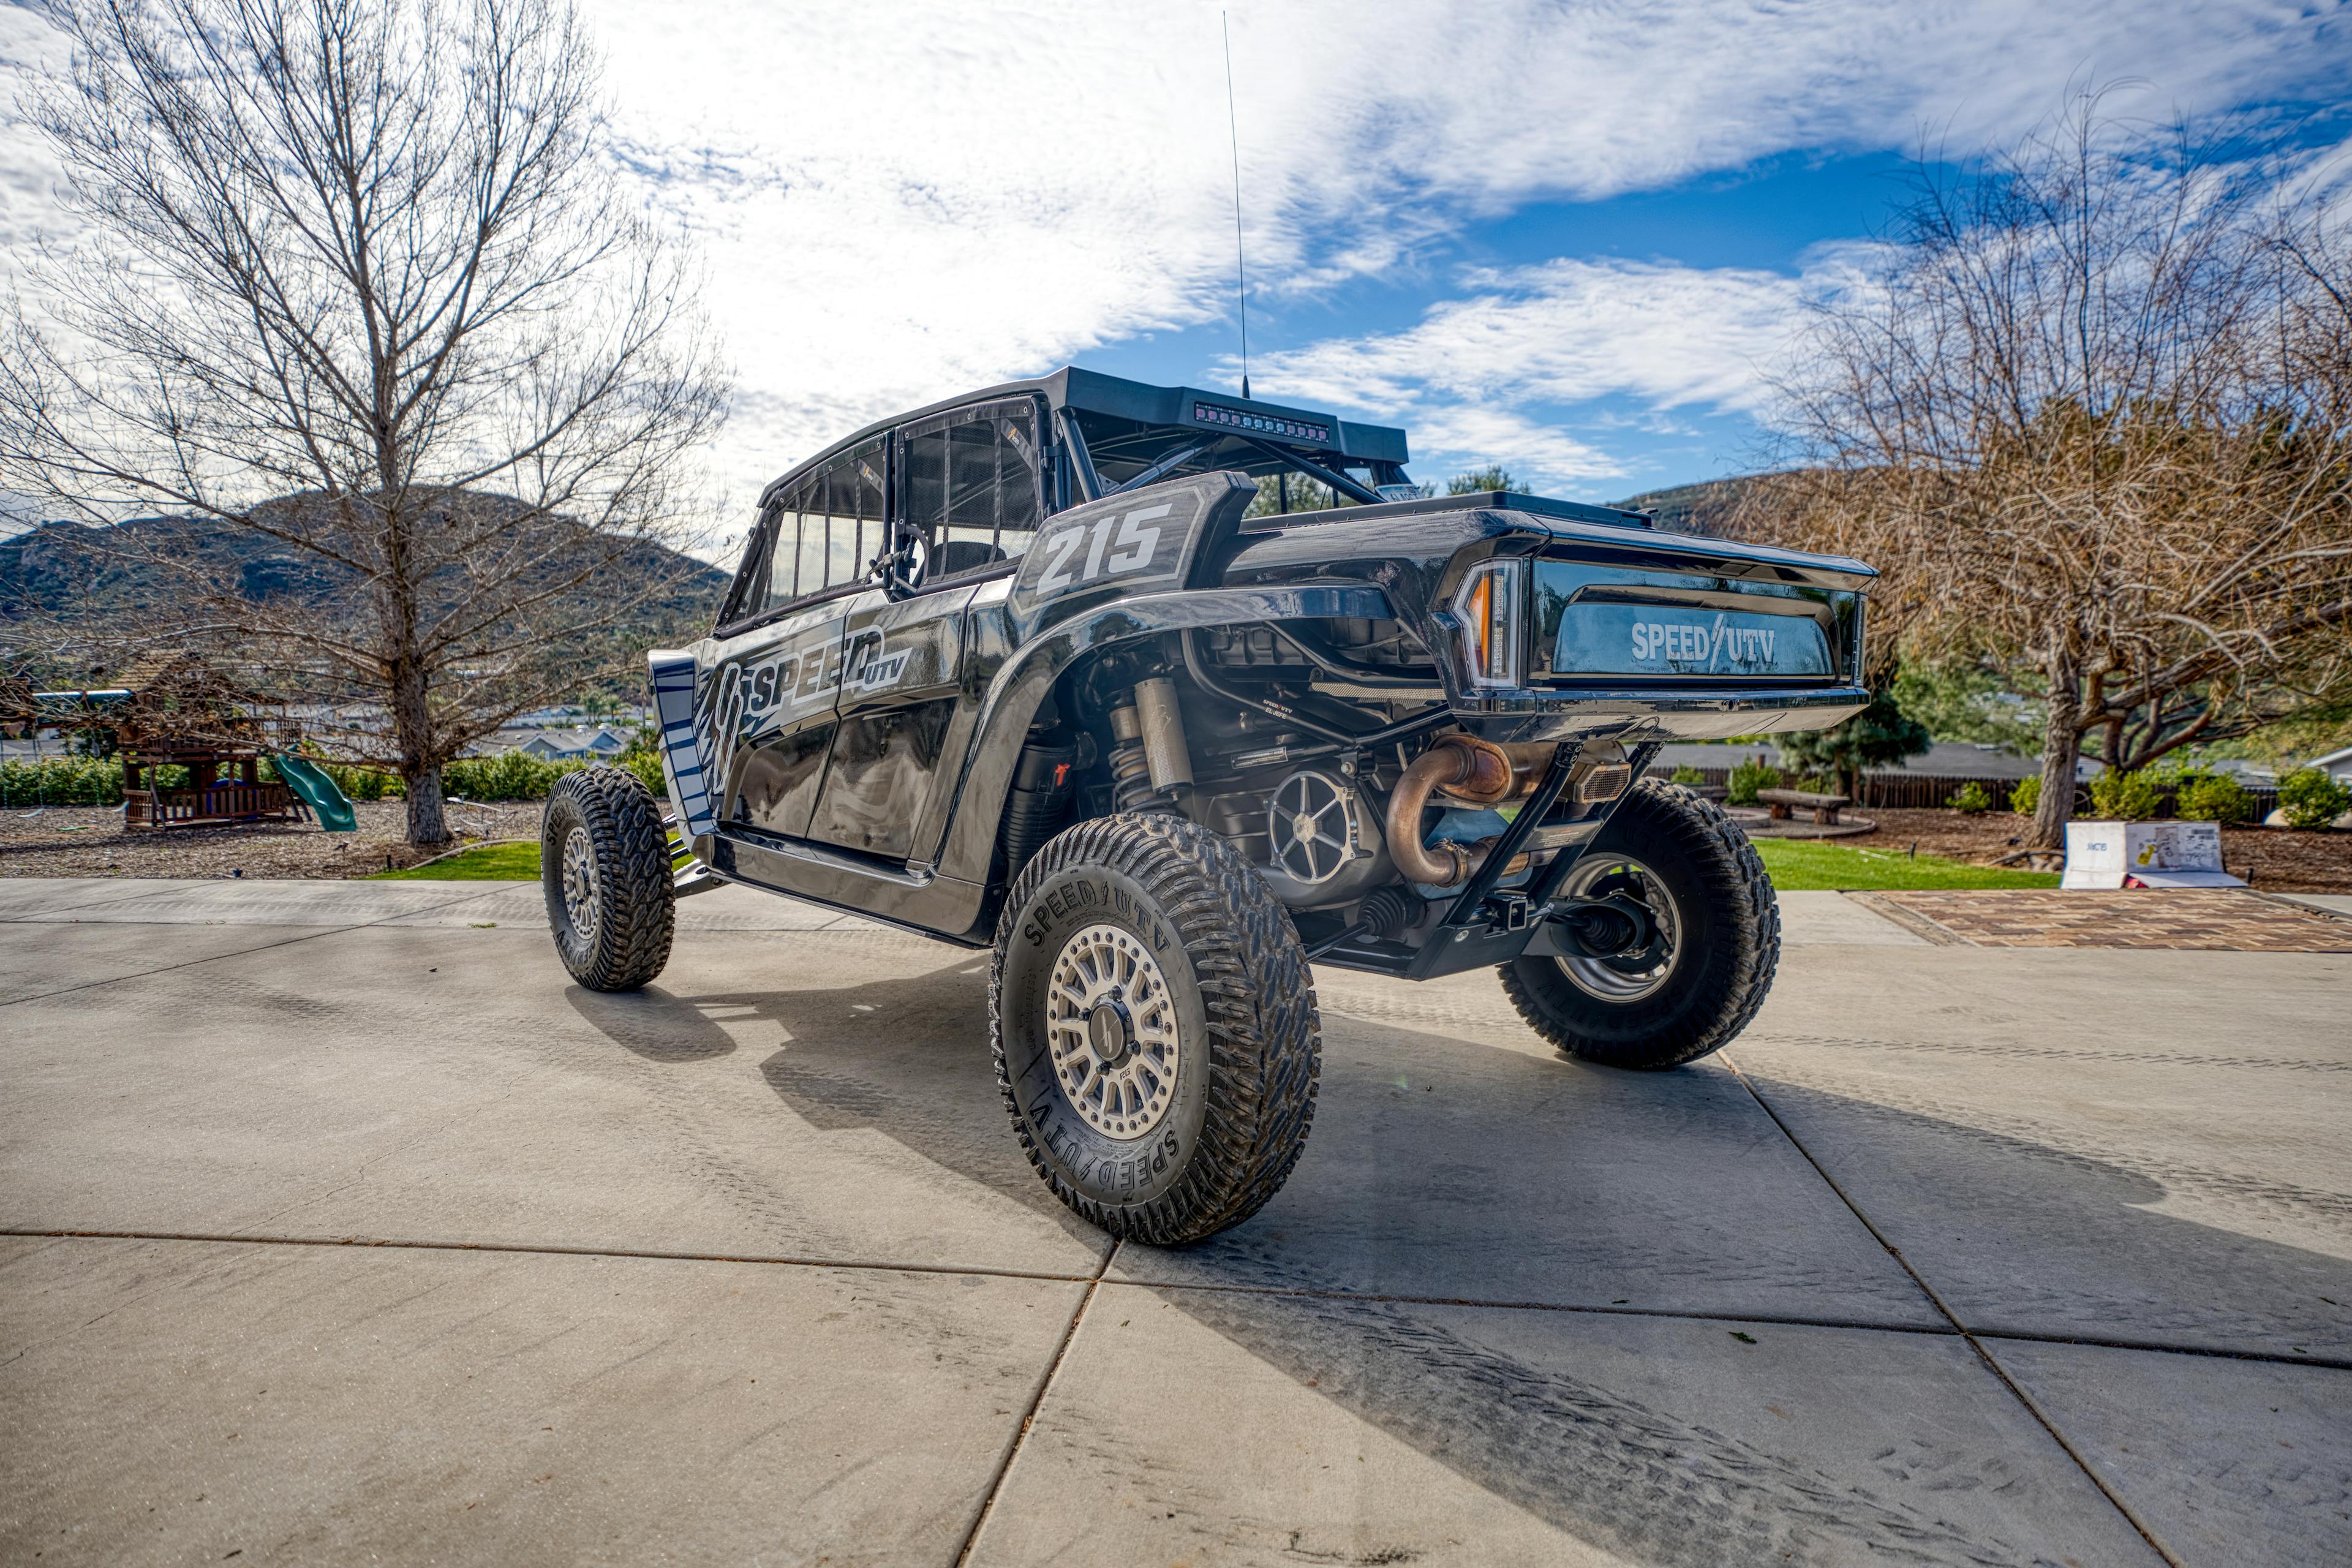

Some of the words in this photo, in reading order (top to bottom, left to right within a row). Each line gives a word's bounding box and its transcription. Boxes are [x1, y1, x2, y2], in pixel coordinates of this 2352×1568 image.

[1036, 503, 1172, 595] 215
[748, 627, 883, 714] SPEED
[864, 656, 905, 685] UTV
[1631, 622, 1710, 662] SPEED
[1727, 628, 1775, 663] UTV
[1263, 699, 1278, 708] SPEED
[1272, 710, 1287, 720] JEFE
[1024, 879, 1096, 947] SPEED
[1114, 886, 1170, 954] UTV
[1029, 1103, 1083, 1175] UTV
[1098, 1129, 1179, 1190] SPEED
